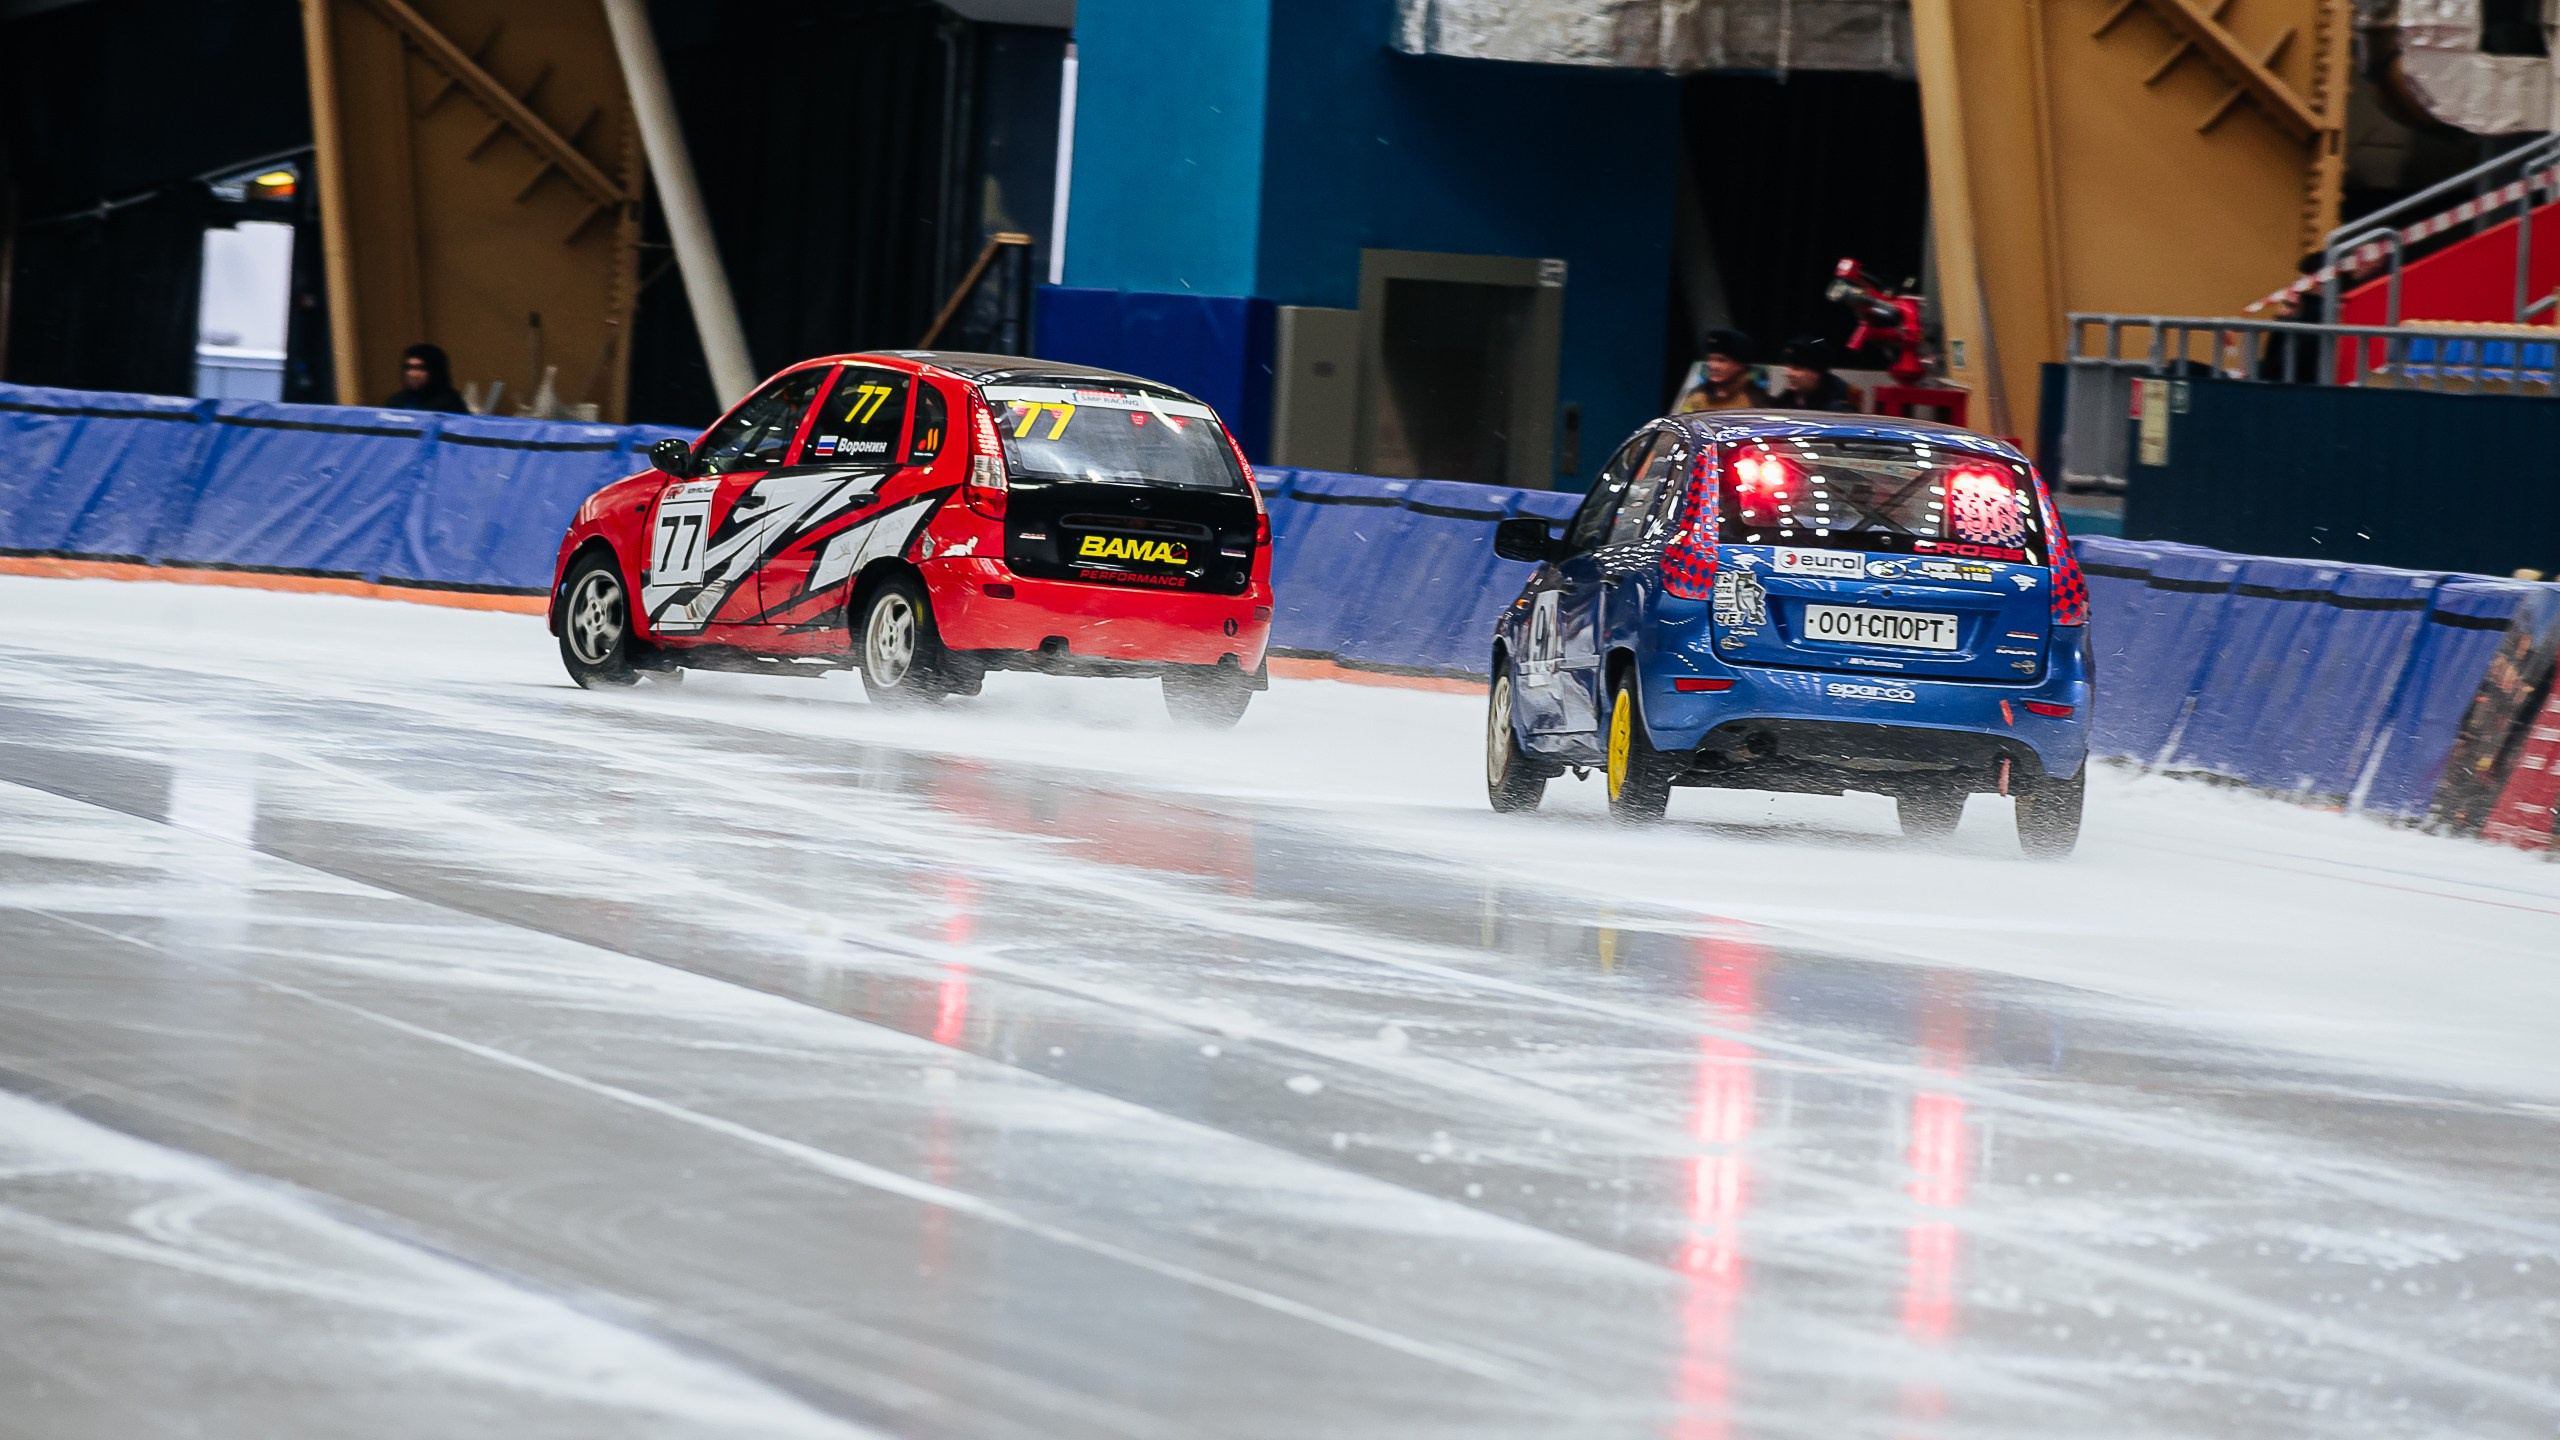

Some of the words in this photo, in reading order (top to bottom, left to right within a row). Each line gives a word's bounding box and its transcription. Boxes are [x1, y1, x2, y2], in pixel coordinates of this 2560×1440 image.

[845, 385, 893, 424] 77
[1104, 398, 1140, 407] RACING
[1007, 401, 1076, 440] 77
[837, 438, 887, 455] Воронин
[659, 515, 703, 572] 77
[1801, 555, 1861, 569] eurol
[1080, 569, 1187, 587] PERFORMANCE
[1826, 682, 1916, 700] sparco
